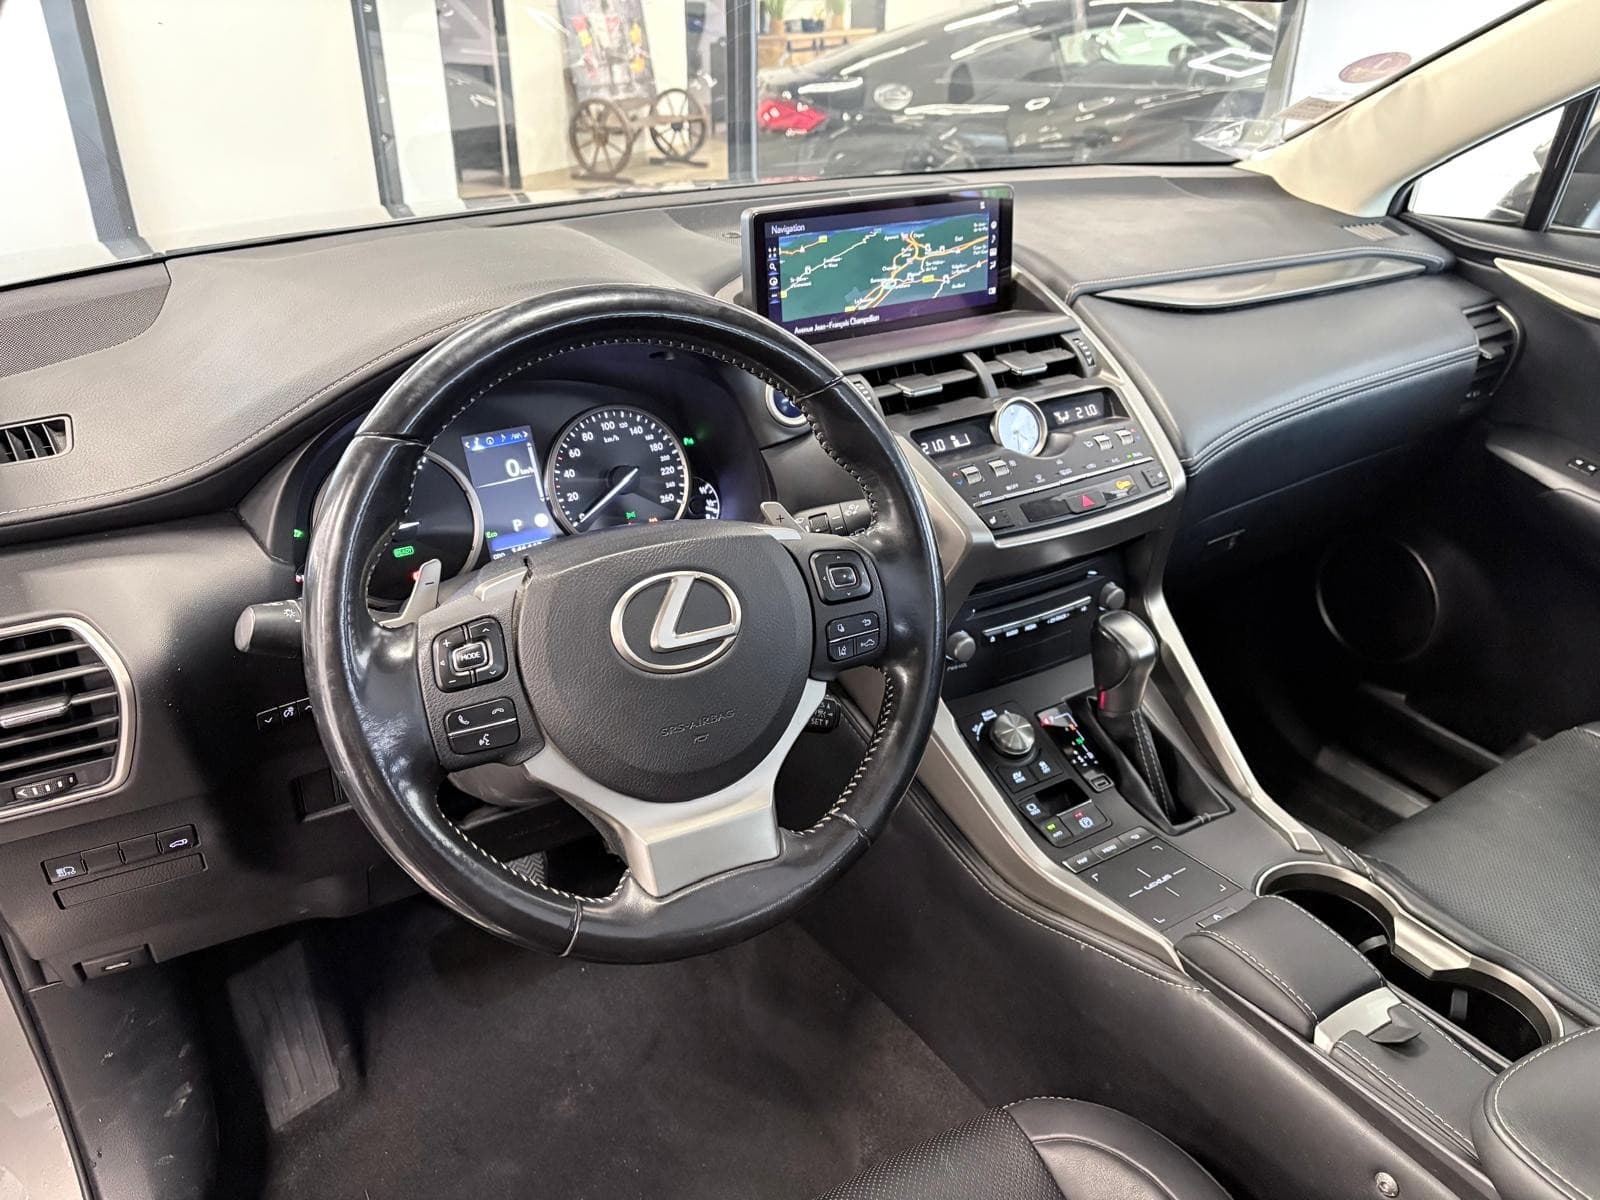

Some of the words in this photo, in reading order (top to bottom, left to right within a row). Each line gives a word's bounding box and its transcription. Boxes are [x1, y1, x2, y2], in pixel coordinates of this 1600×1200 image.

[771, 223, 806, 235] Navigation
[600, 421, 616, 431] 100
[629, 426, 643, 436] 140
[582, 432, 594, 442] 80
[604, 434, 620, 444] km/h
[649, 442, 664, 452] 180
[568, 448, 581, 458] 60
[505, 458, 520, 477] 0
[660, 466, 675, 476] 220
[563, 469, 576, 479] 40
[566, 492, 579, 502] 20
[659, 493, 675, 504] 260
[512, 518, 523, 532] P
[460, 651, 482, 662] MODE
[1143, 873, 1173, 891] LEXUS
